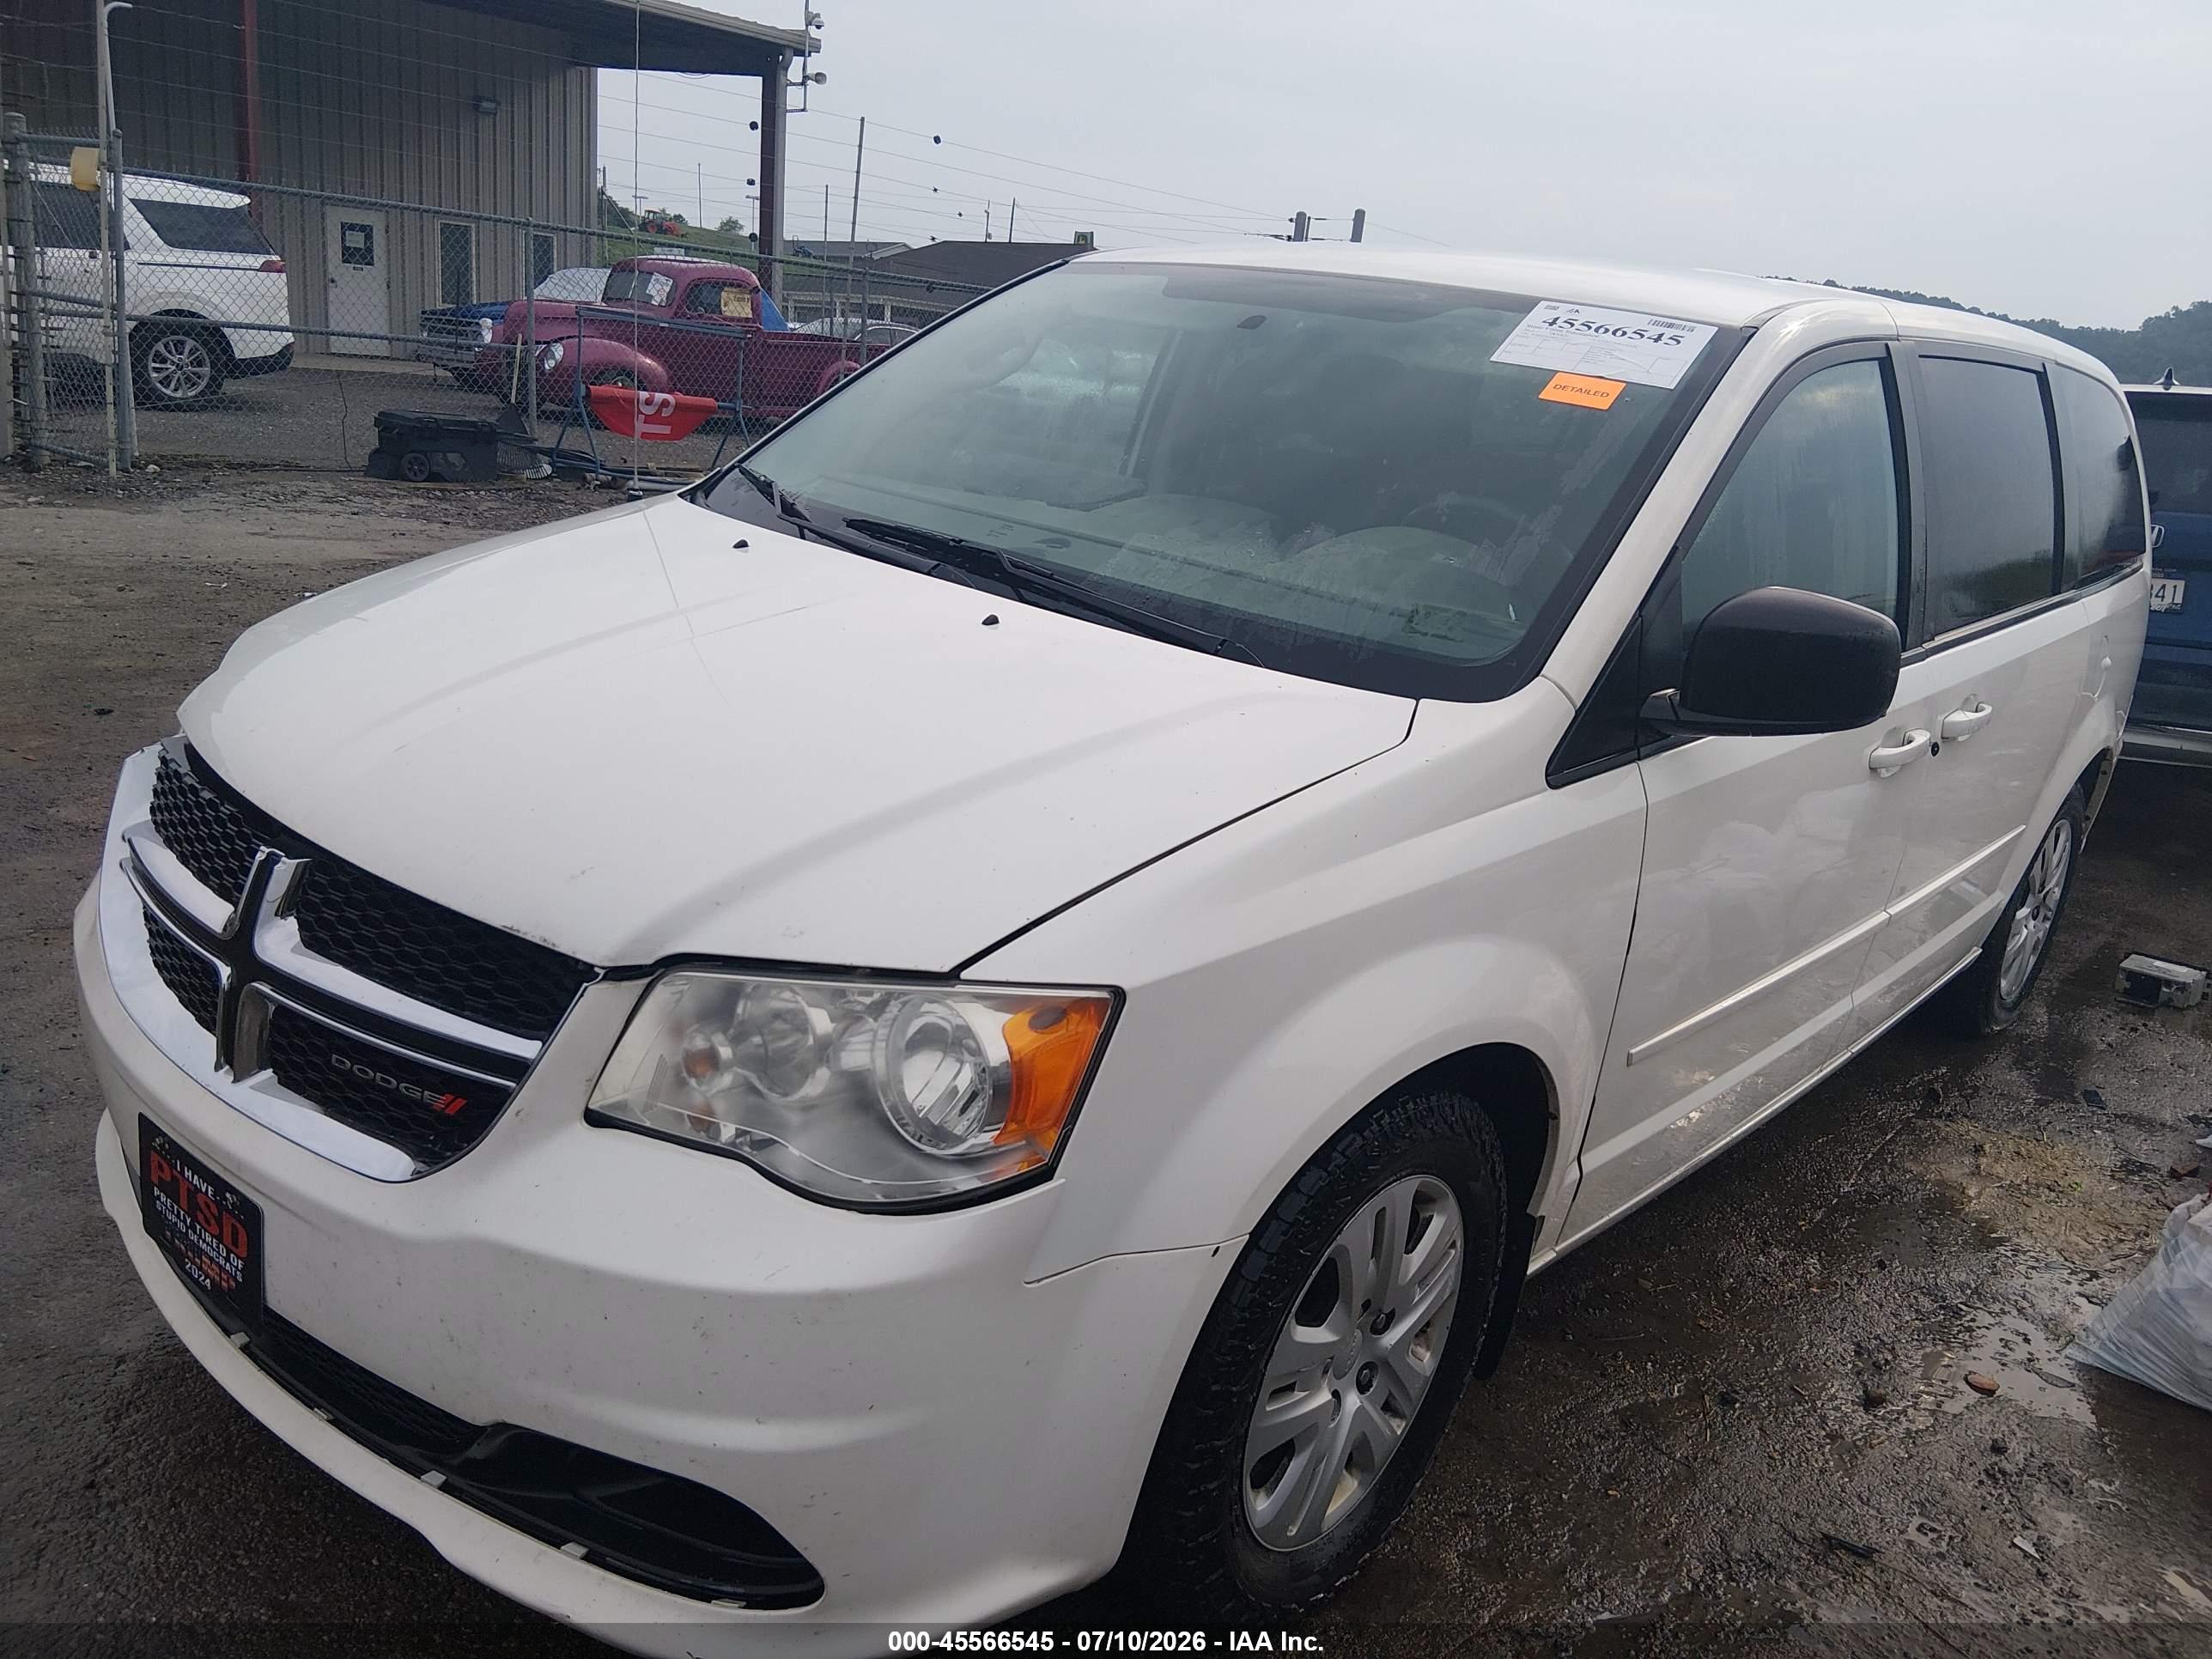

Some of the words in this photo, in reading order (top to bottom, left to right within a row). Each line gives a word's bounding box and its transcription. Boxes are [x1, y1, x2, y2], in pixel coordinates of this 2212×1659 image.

[1541, 315, 1685, 347] 45566545
[1552, 383, 1609, 398] DETAILED
[2150, 583, 2178, 604] 41
[331, 1054, 447, 1108] DODGE
[184, 1165, 216, 1200] HAVE
[150, 1149, 248, 1258] PTSD
[154, 1186, 191, 1226] PRETTY
[195, 1222, 227, 1255] TIRED
[230, 1253, 245, 1270] OF
[155, 1200, 186, 1233] STUPID
[188, 1230, 243, 1283] DEMOCRATS
[184, 1257, 212, 1291] 2024
